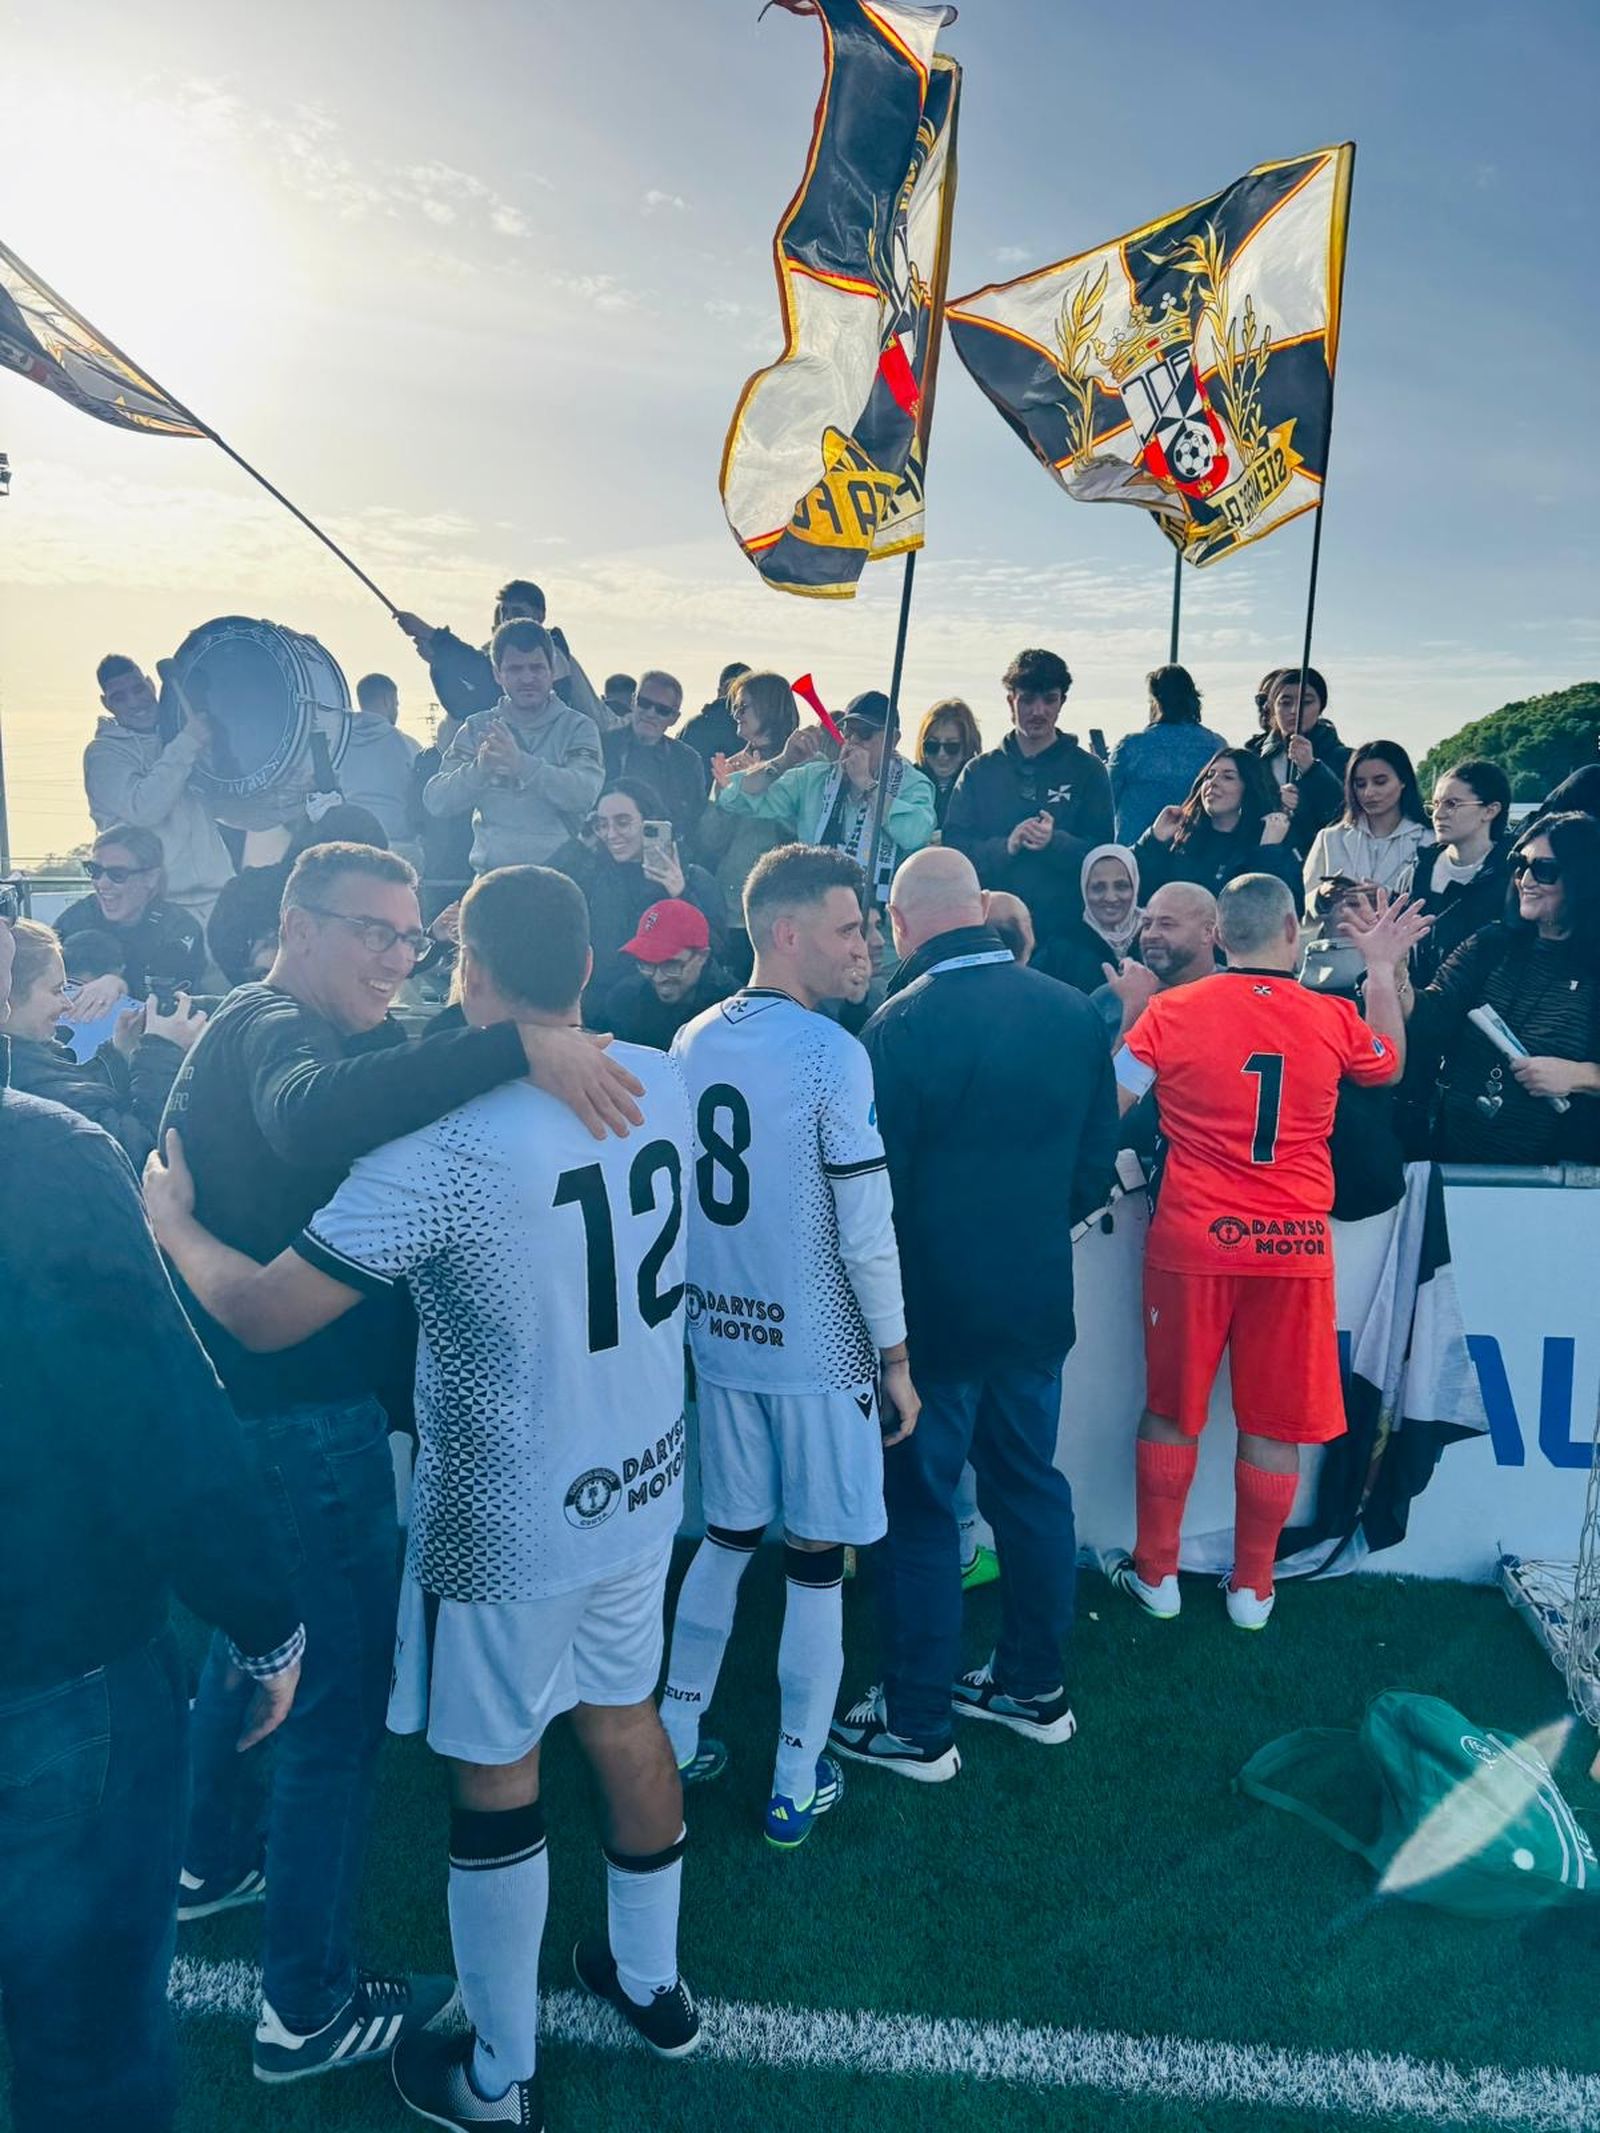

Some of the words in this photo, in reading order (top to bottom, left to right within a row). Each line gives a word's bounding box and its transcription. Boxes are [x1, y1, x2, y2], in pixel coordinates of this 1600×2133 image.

[1240, 1052, 1285, 1164] 1
[694, 1083, 752, 1227] 8
[1251, 1219, 1326, 1236] DARYSO
[552, 1139, 686, 1354] 12
[1255, 1238, 1325, 1256] MOTOR
[706, 1290, 785, 1323] DARYSO
[709, 1315, 785, 1347] MOTOR
[627, 1442, 686, 1513] MOTO
[665, 1685, 701, 1702] EUTA
